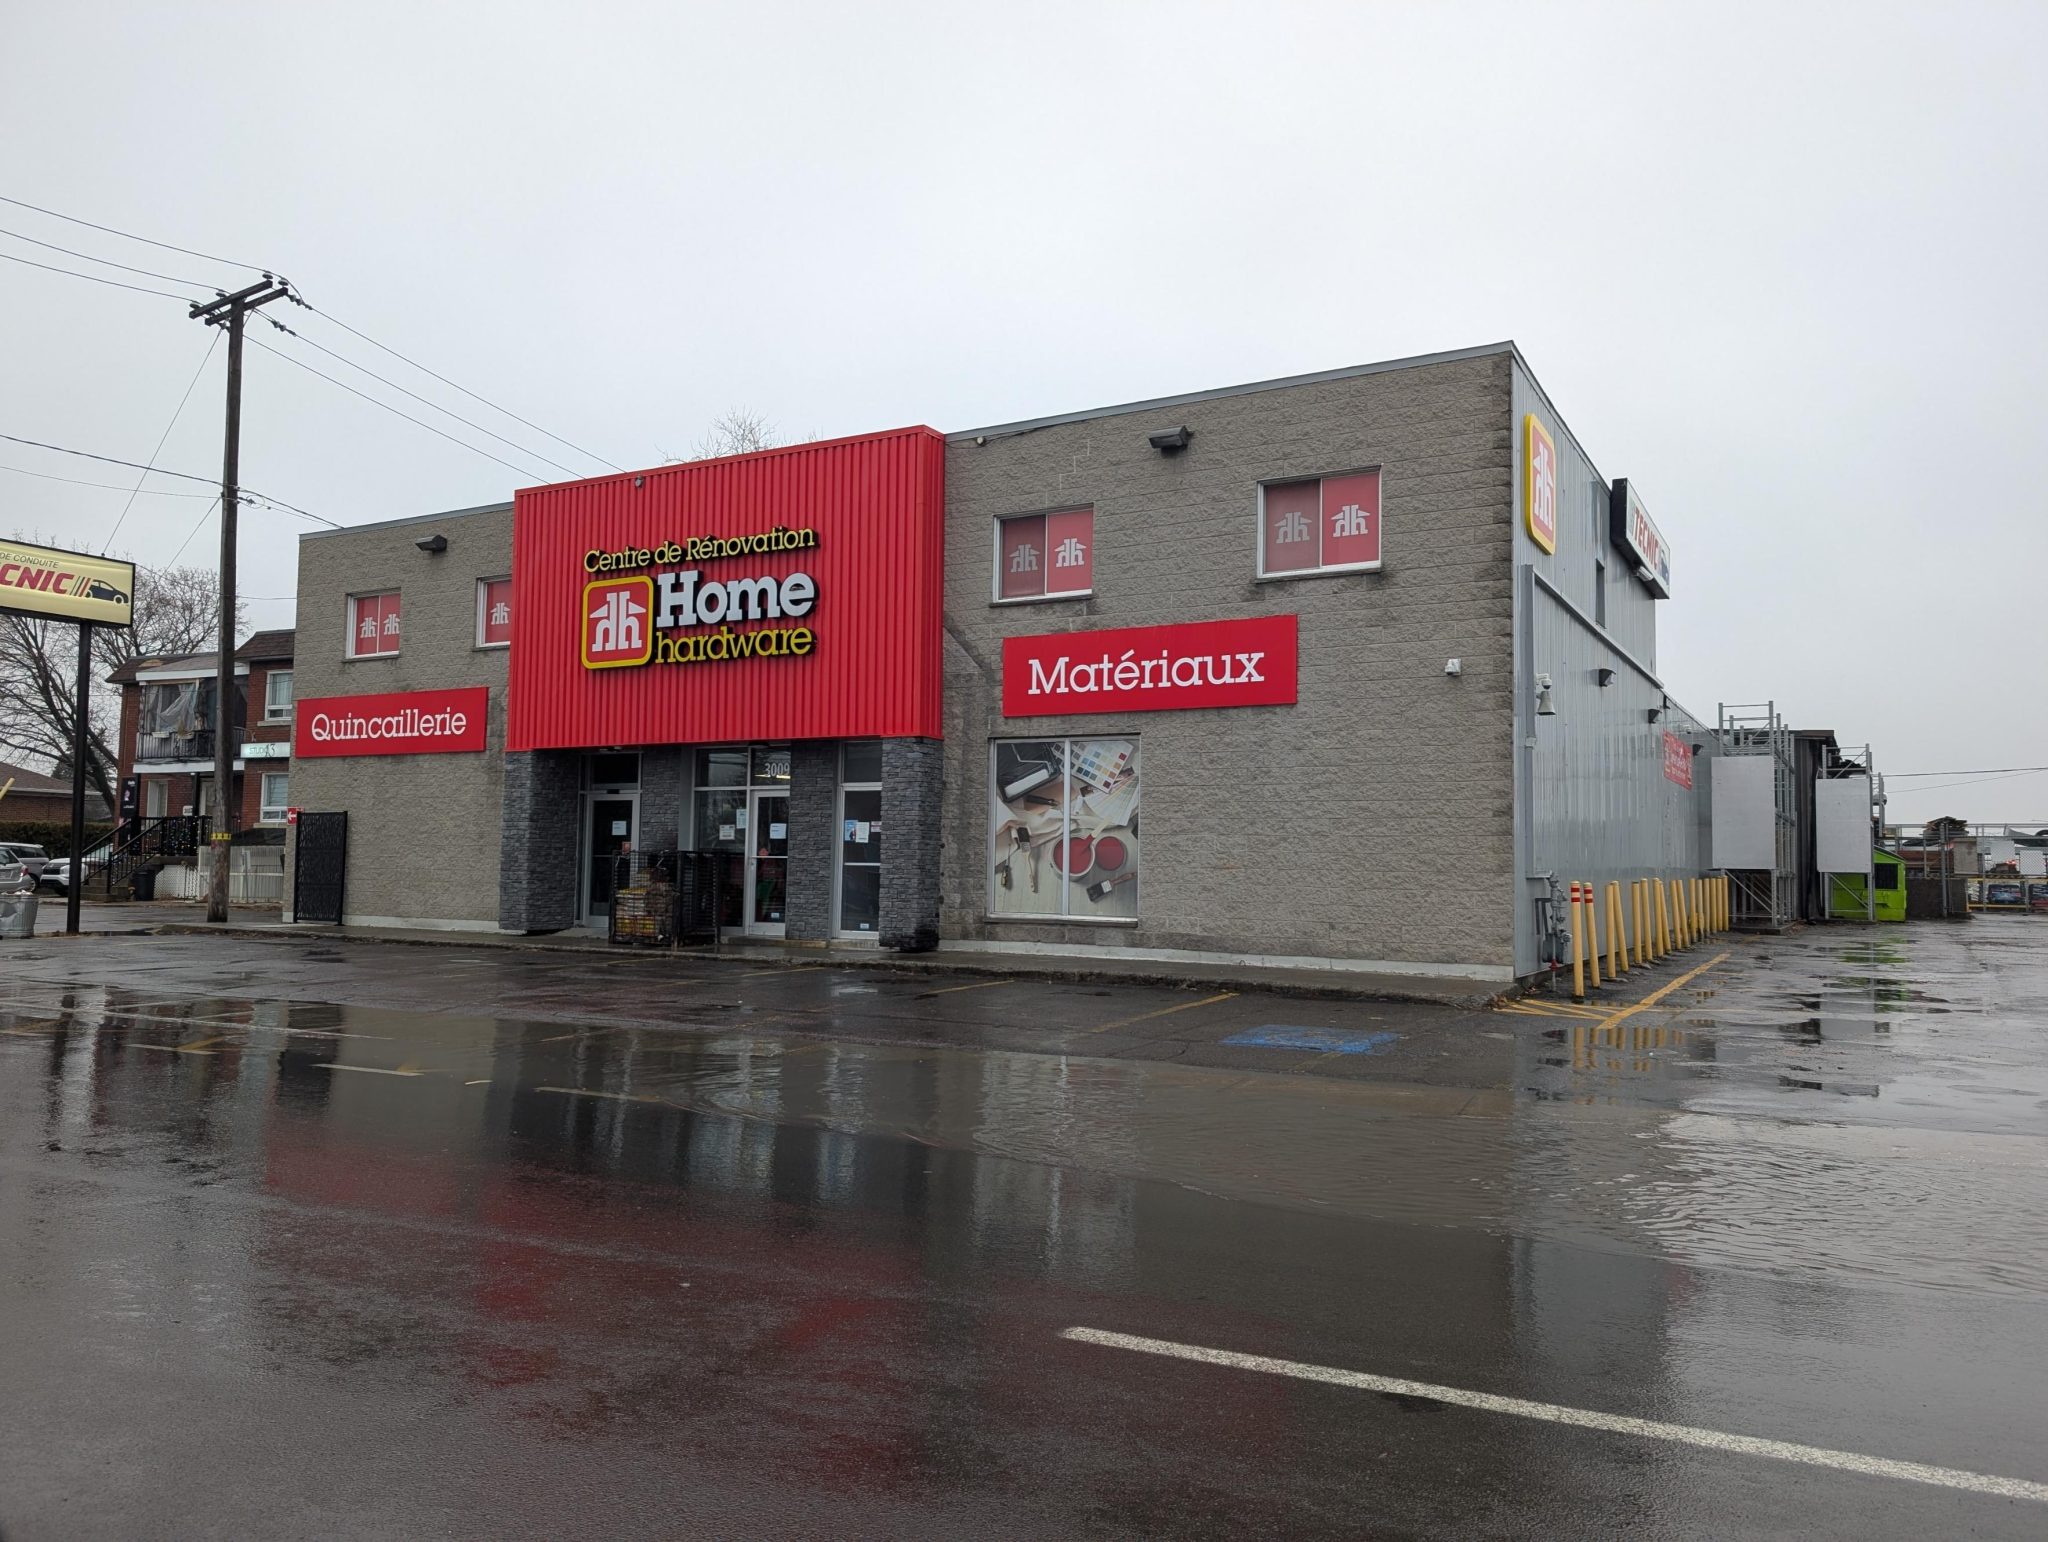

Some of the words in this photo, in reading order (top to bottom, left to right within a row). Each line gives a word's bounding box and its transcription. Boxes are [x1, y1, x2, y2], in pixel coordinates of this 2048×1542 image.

[584, 546, 651, 573] Centre
[654, 541, 682, 564] de
[686, 526, 815, 560] Rénovation
[1633, 506, 1659, 570] TECNIC
[13, 554, 60, 569] CONDUITE
[656, 570, 815, 628] Home
[655, 626, 813, 664] hardware
[1028, 649, 1265, 695] Matériaux
[311, 706, 467, 741] Quincaillerie
[764, 762, 791, 777] 3009
